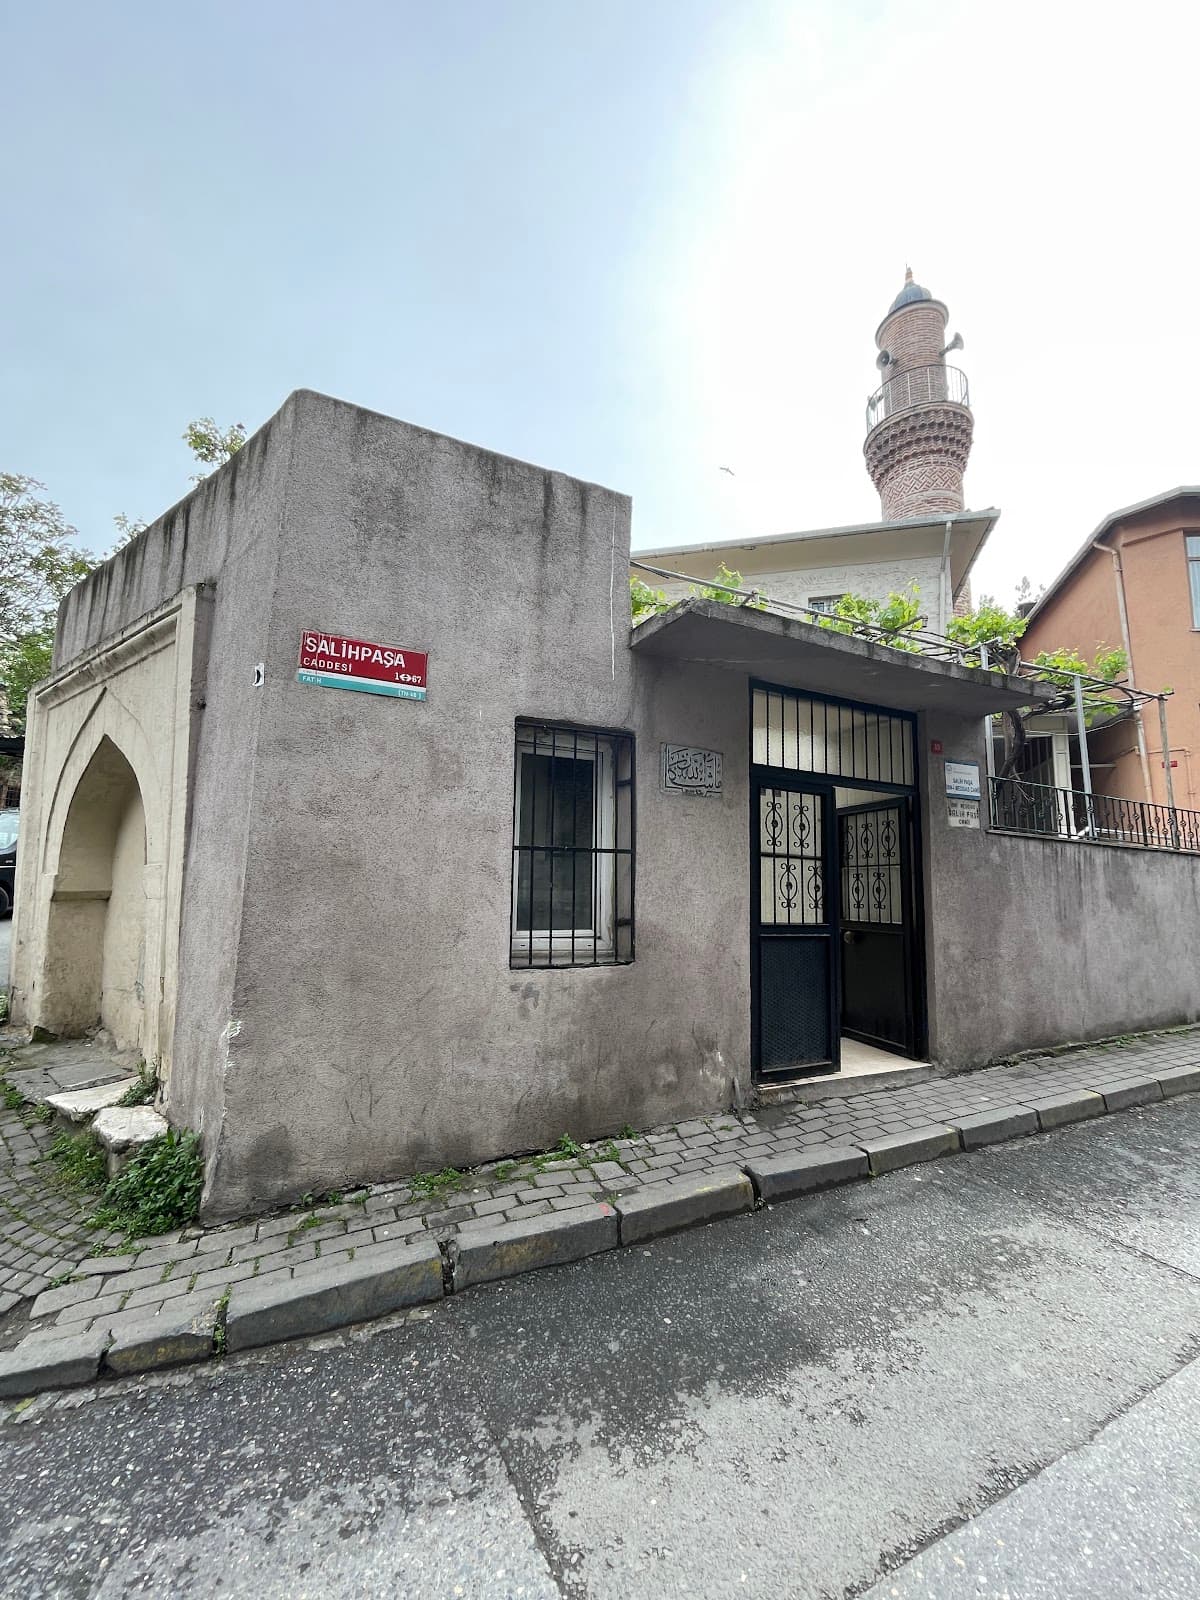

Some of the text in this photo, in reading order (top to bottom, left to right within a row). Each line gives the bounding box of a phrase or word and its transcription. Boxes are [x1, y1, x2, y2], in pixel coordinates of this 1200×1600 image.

[305, 637, 405, 668] SALİHPAŞA
[303, 657, 352, 673] CADDESİ
[302, 675, 322, 685] FATH
